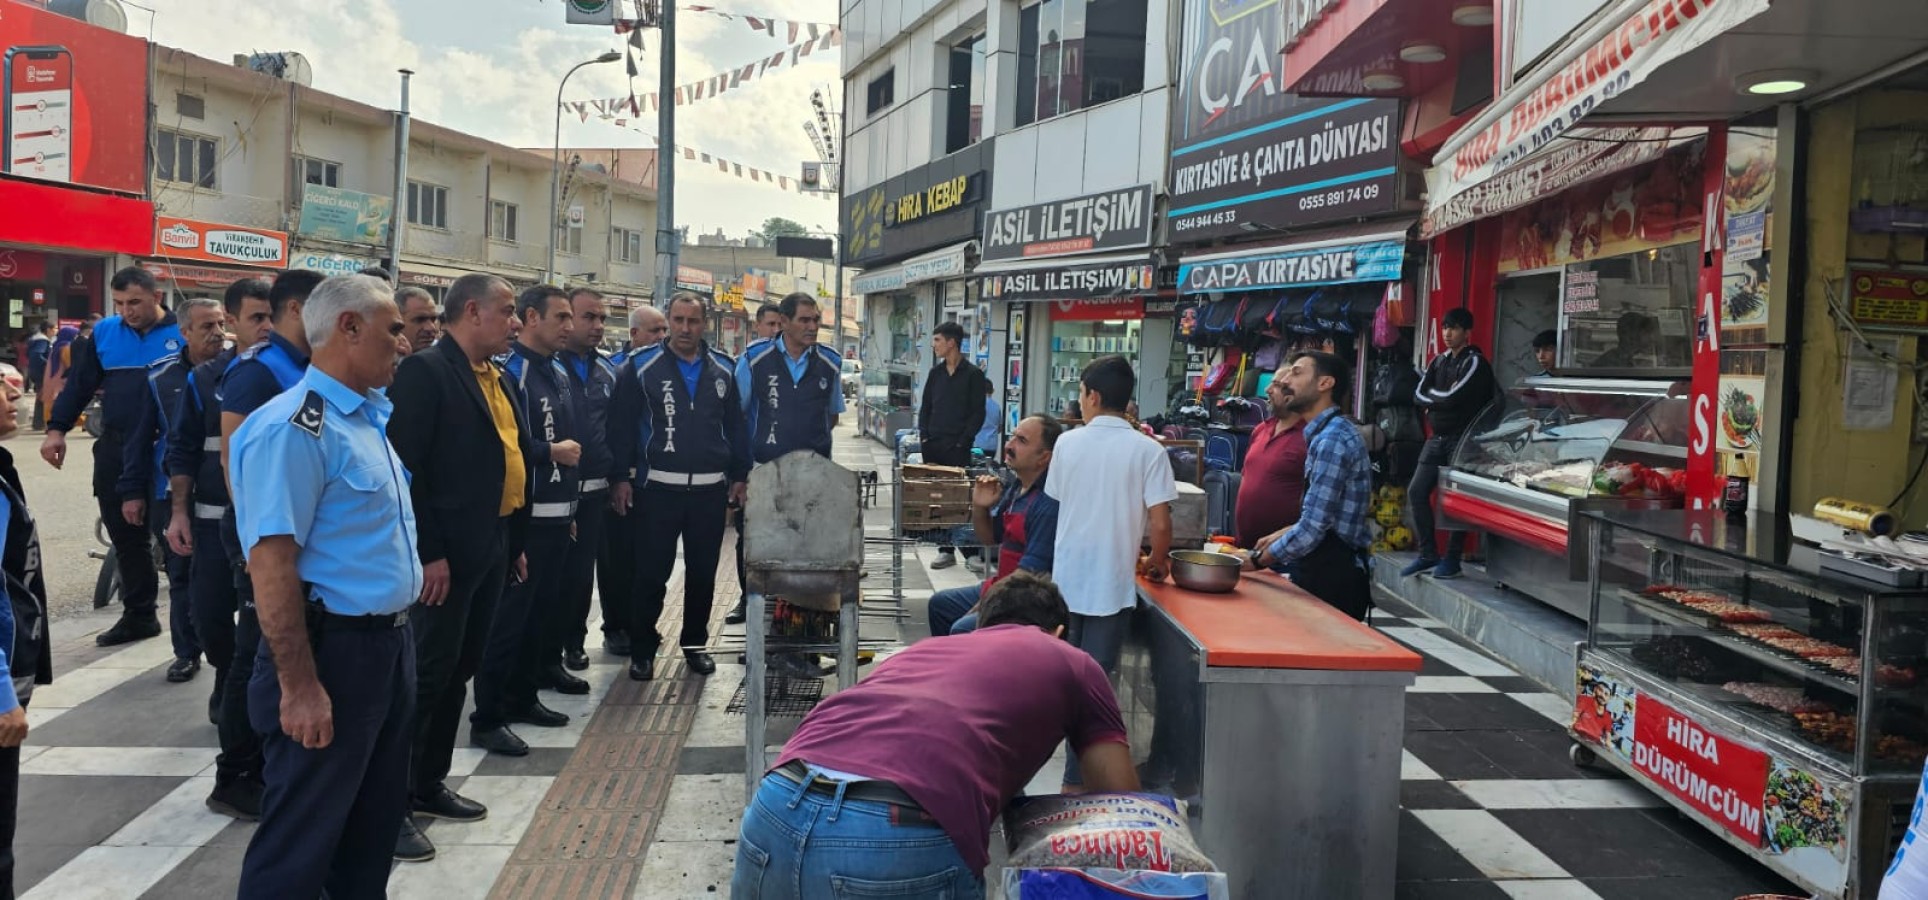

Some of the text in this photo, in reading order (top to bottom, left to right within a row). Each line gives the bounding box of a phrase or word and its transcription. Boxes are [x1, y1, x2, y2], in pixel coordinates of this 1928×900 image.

[1175, 115, 1389, 196] KIRTASİYE & ÇANTA DÜNYASI
[927, 178, 967, 214] KEBAP
[1299, 184, 1380, 211] 0555 891 74 09
[164, 231, 197, 245] Banvit
[990, 190, 1143, 247] ASİL İLETİŞİM
[1176, 210, 1237, 231] 0544 944 45 33
[209, 241, 279, 260] TAVUKÇULUK
[1257, 251, 1353, 284] KIRTASİYE
[1004, 267, 1123, 294] ASİL İLETİŞİM
[662, 380, 676, 453] ZABITA
[766, 375, 779, 445] ZABTA
[540, 396, 562, 483] ZABA
[1667, 716, 1719, 765] HİRA
[1635, 741, 1760, 835] DÜRÜMCÜM
